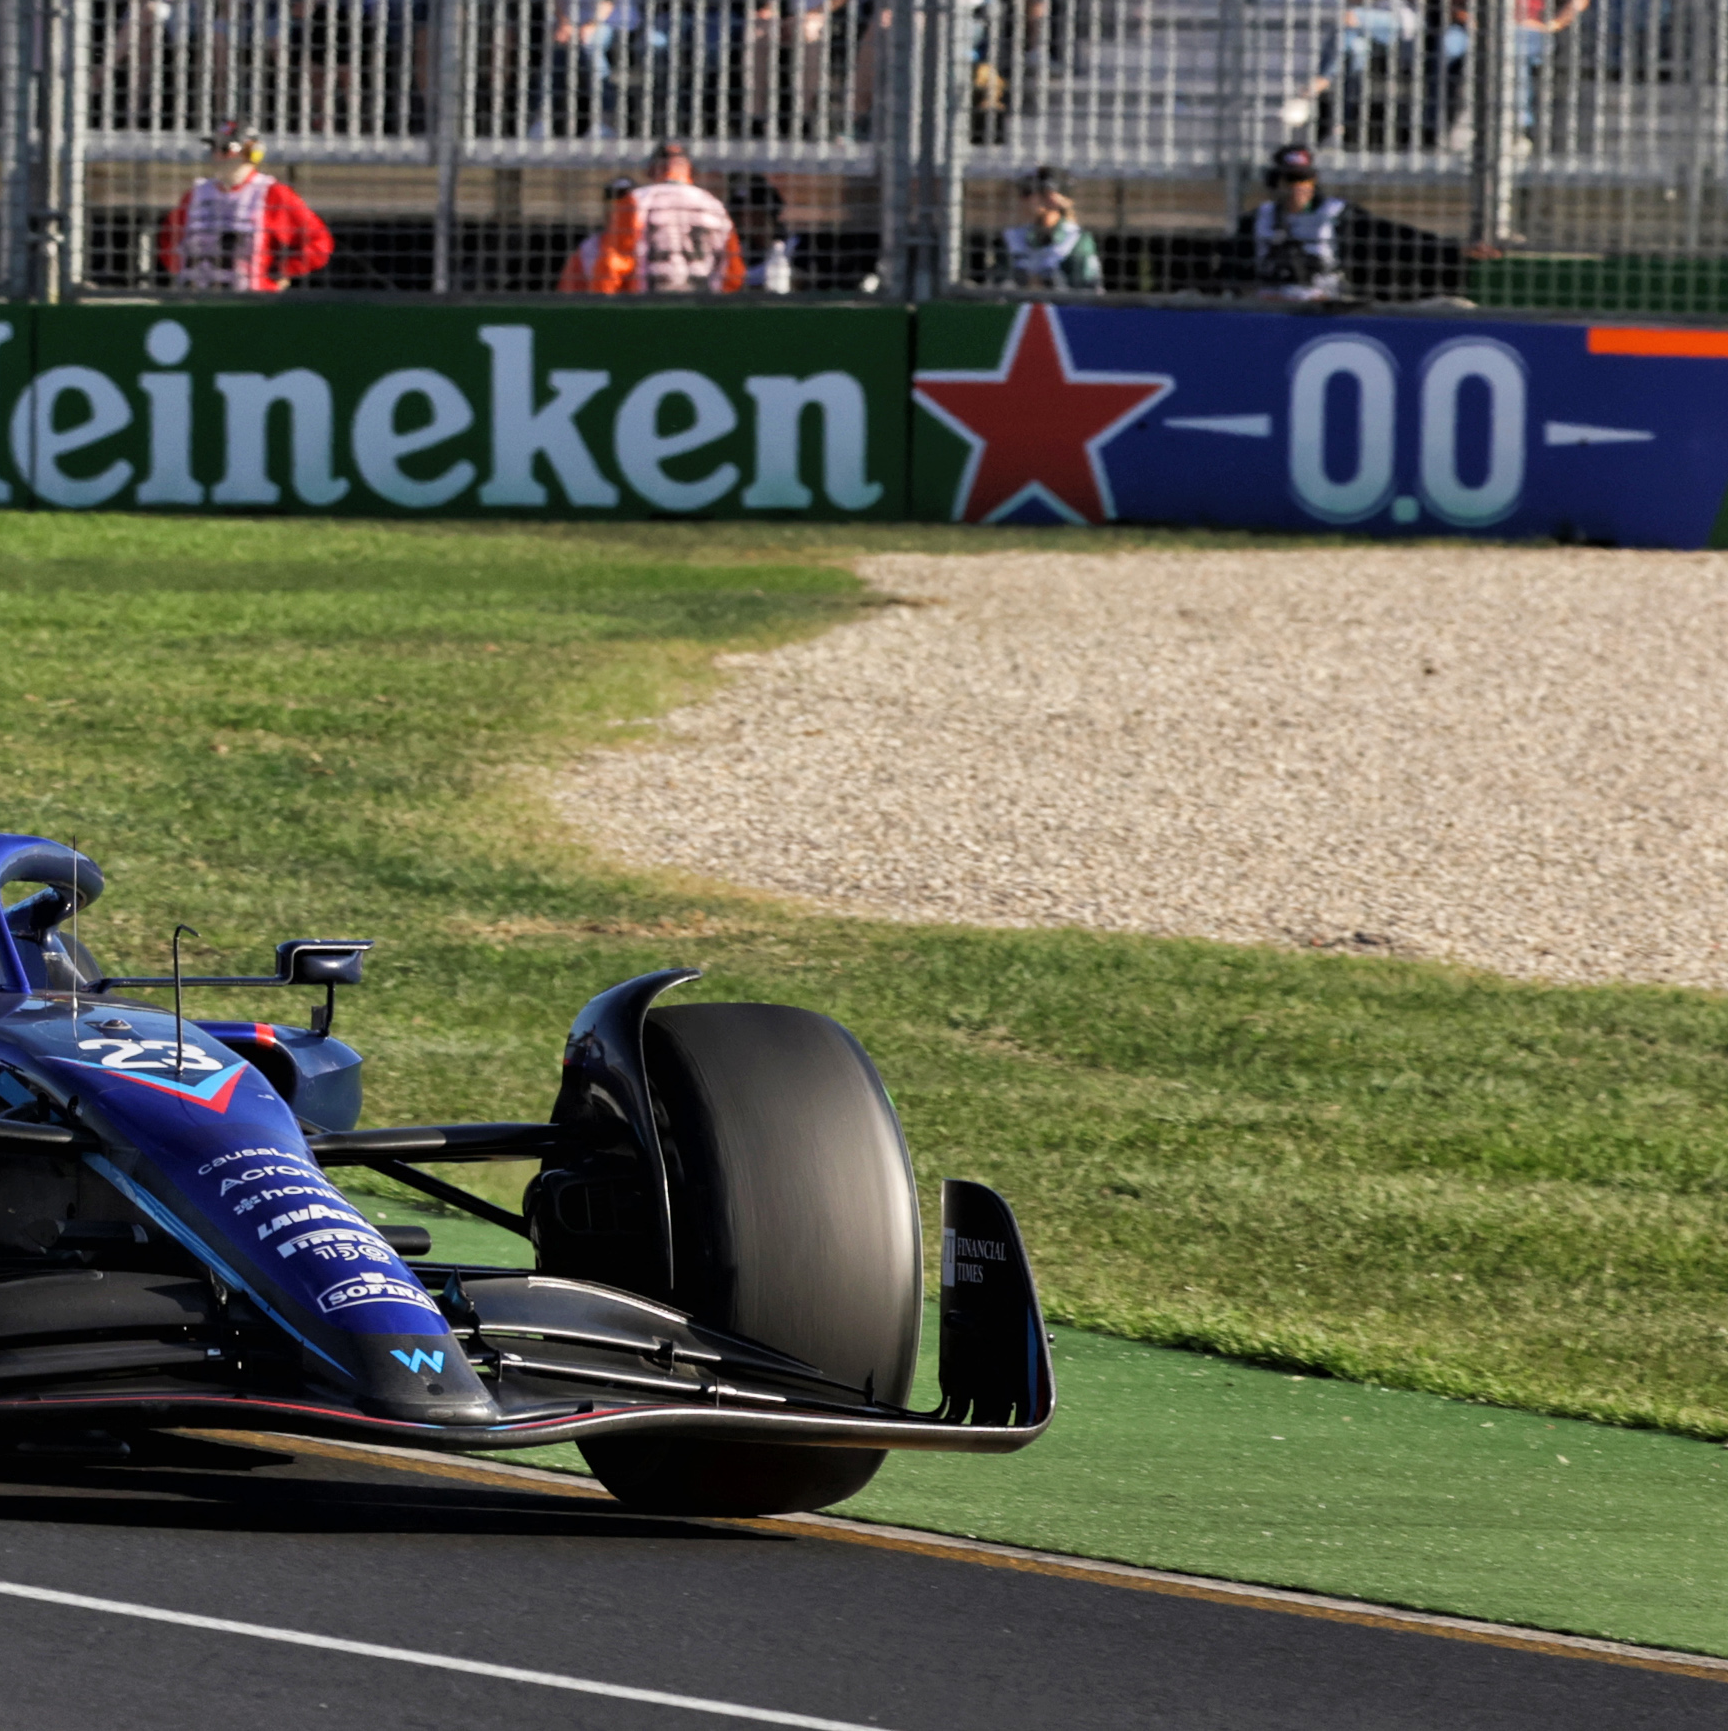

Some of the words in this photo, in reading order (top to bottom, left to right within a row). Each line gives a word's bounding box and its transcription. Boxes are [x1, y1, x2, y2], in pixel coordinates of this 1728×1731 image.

[1290, 332, 1528, 528] 0.0
[78, 1039, 224, 1071] 23
[956, 1236, 1007, 1261] FINANCIAL
[956, 1262, 984, 1284] TIMES
[328, 1283, 431, 1307] SOFINA
